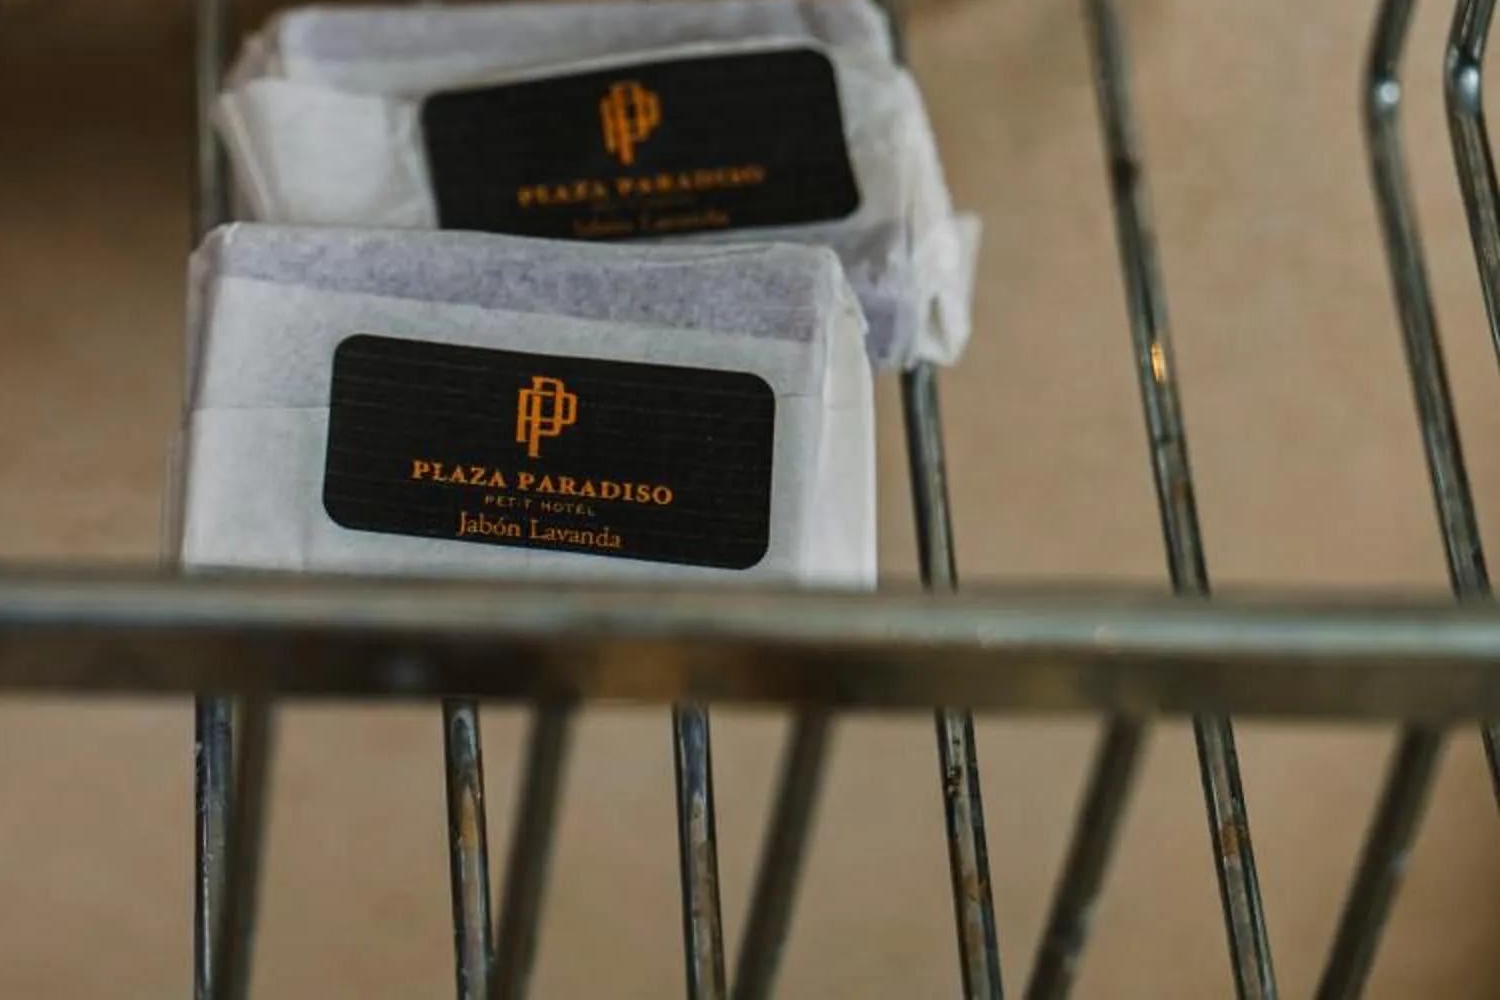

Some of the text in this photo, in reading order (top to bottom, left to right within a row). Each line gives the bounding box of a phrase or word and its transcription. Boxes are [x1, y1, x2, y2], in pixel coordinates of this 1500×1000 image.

[411, 459, 674, 506] PLAZA PARADISO
[456, 509, 623, 549] Jabón Lavanda
